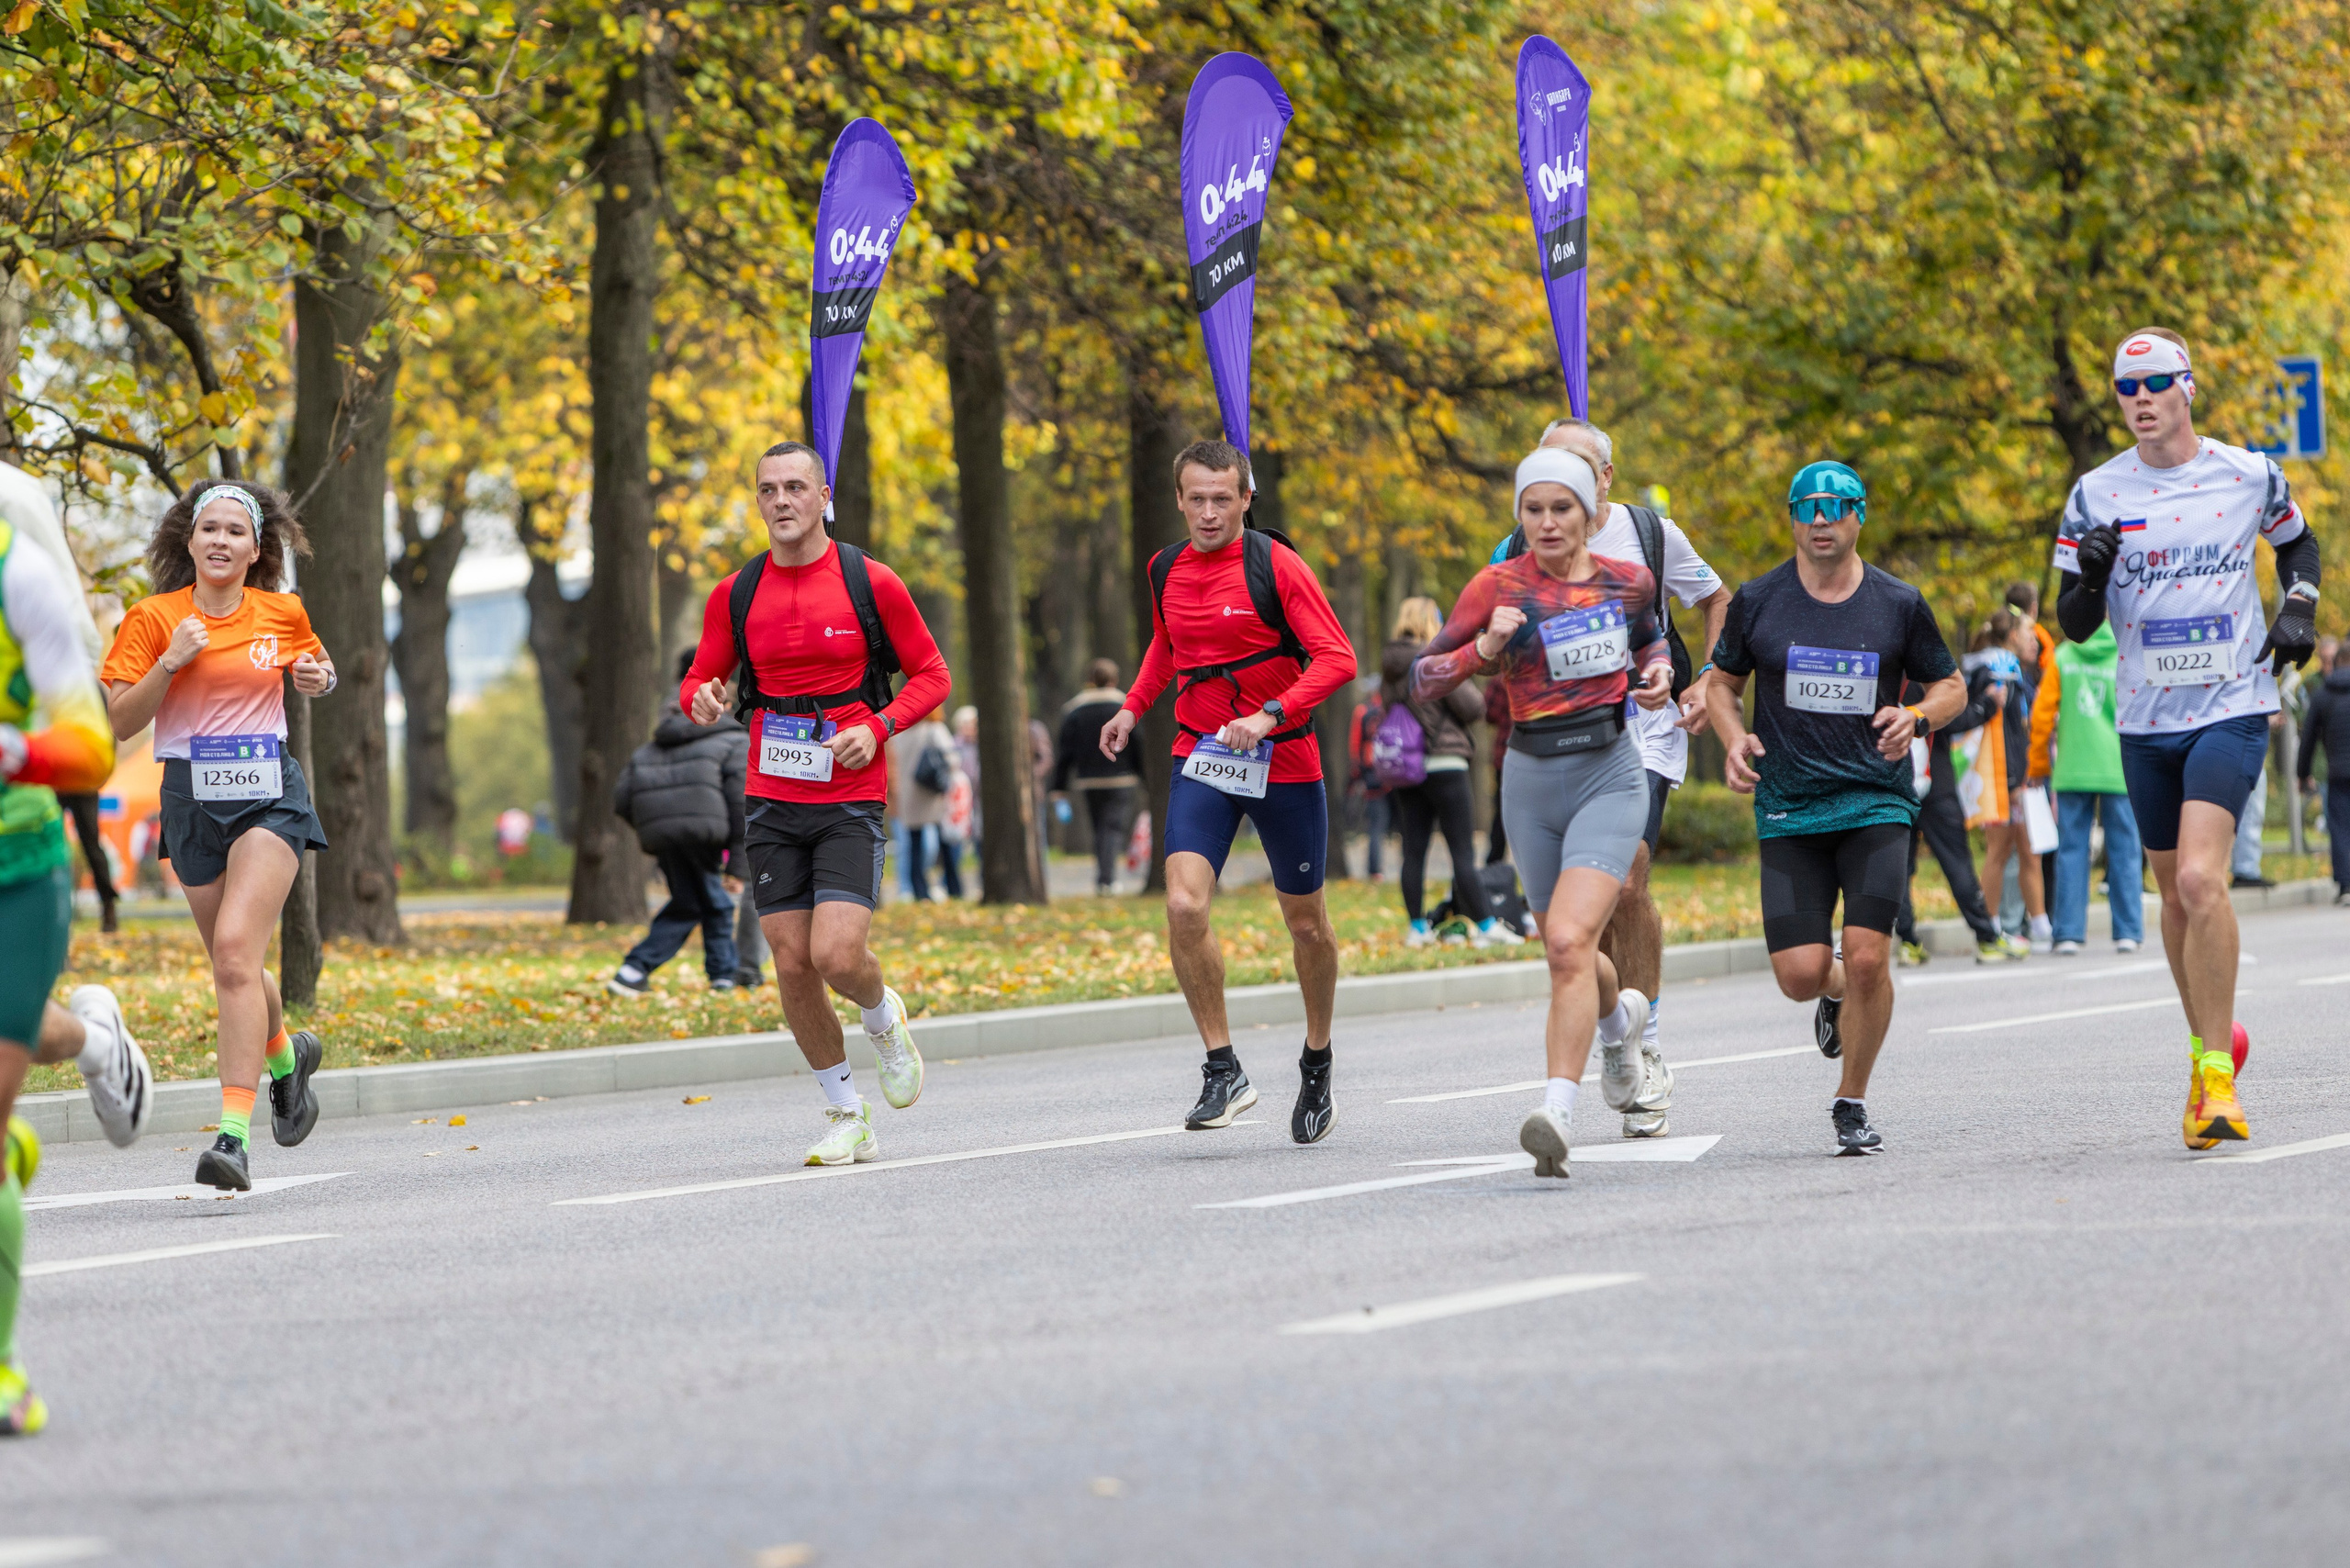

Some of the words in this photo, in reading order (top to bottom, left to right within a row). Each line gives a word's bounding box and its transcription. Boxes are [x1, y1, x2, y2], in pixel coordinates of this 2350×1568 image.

[1200, 154, 1267, 225] 0:44
[830, 225, 890, 265] 0:44
[1208, 263, 1223, 287] 10
[825, 304, 839, 322] 10
[2148, 543, 2220, 567] ФЕРРУМ
[2115, 551, 2249, 588] Ярославль
[1562, 639, 1616, 666] 12728
[2156, 652, 2212, 671] 10222
[1798, 681, 1854, 700] 10232
[767, 746, 812, 766] 12993
[202, 768, 260, 786] 12366
[1194, 760, 1248, 782] 12994
